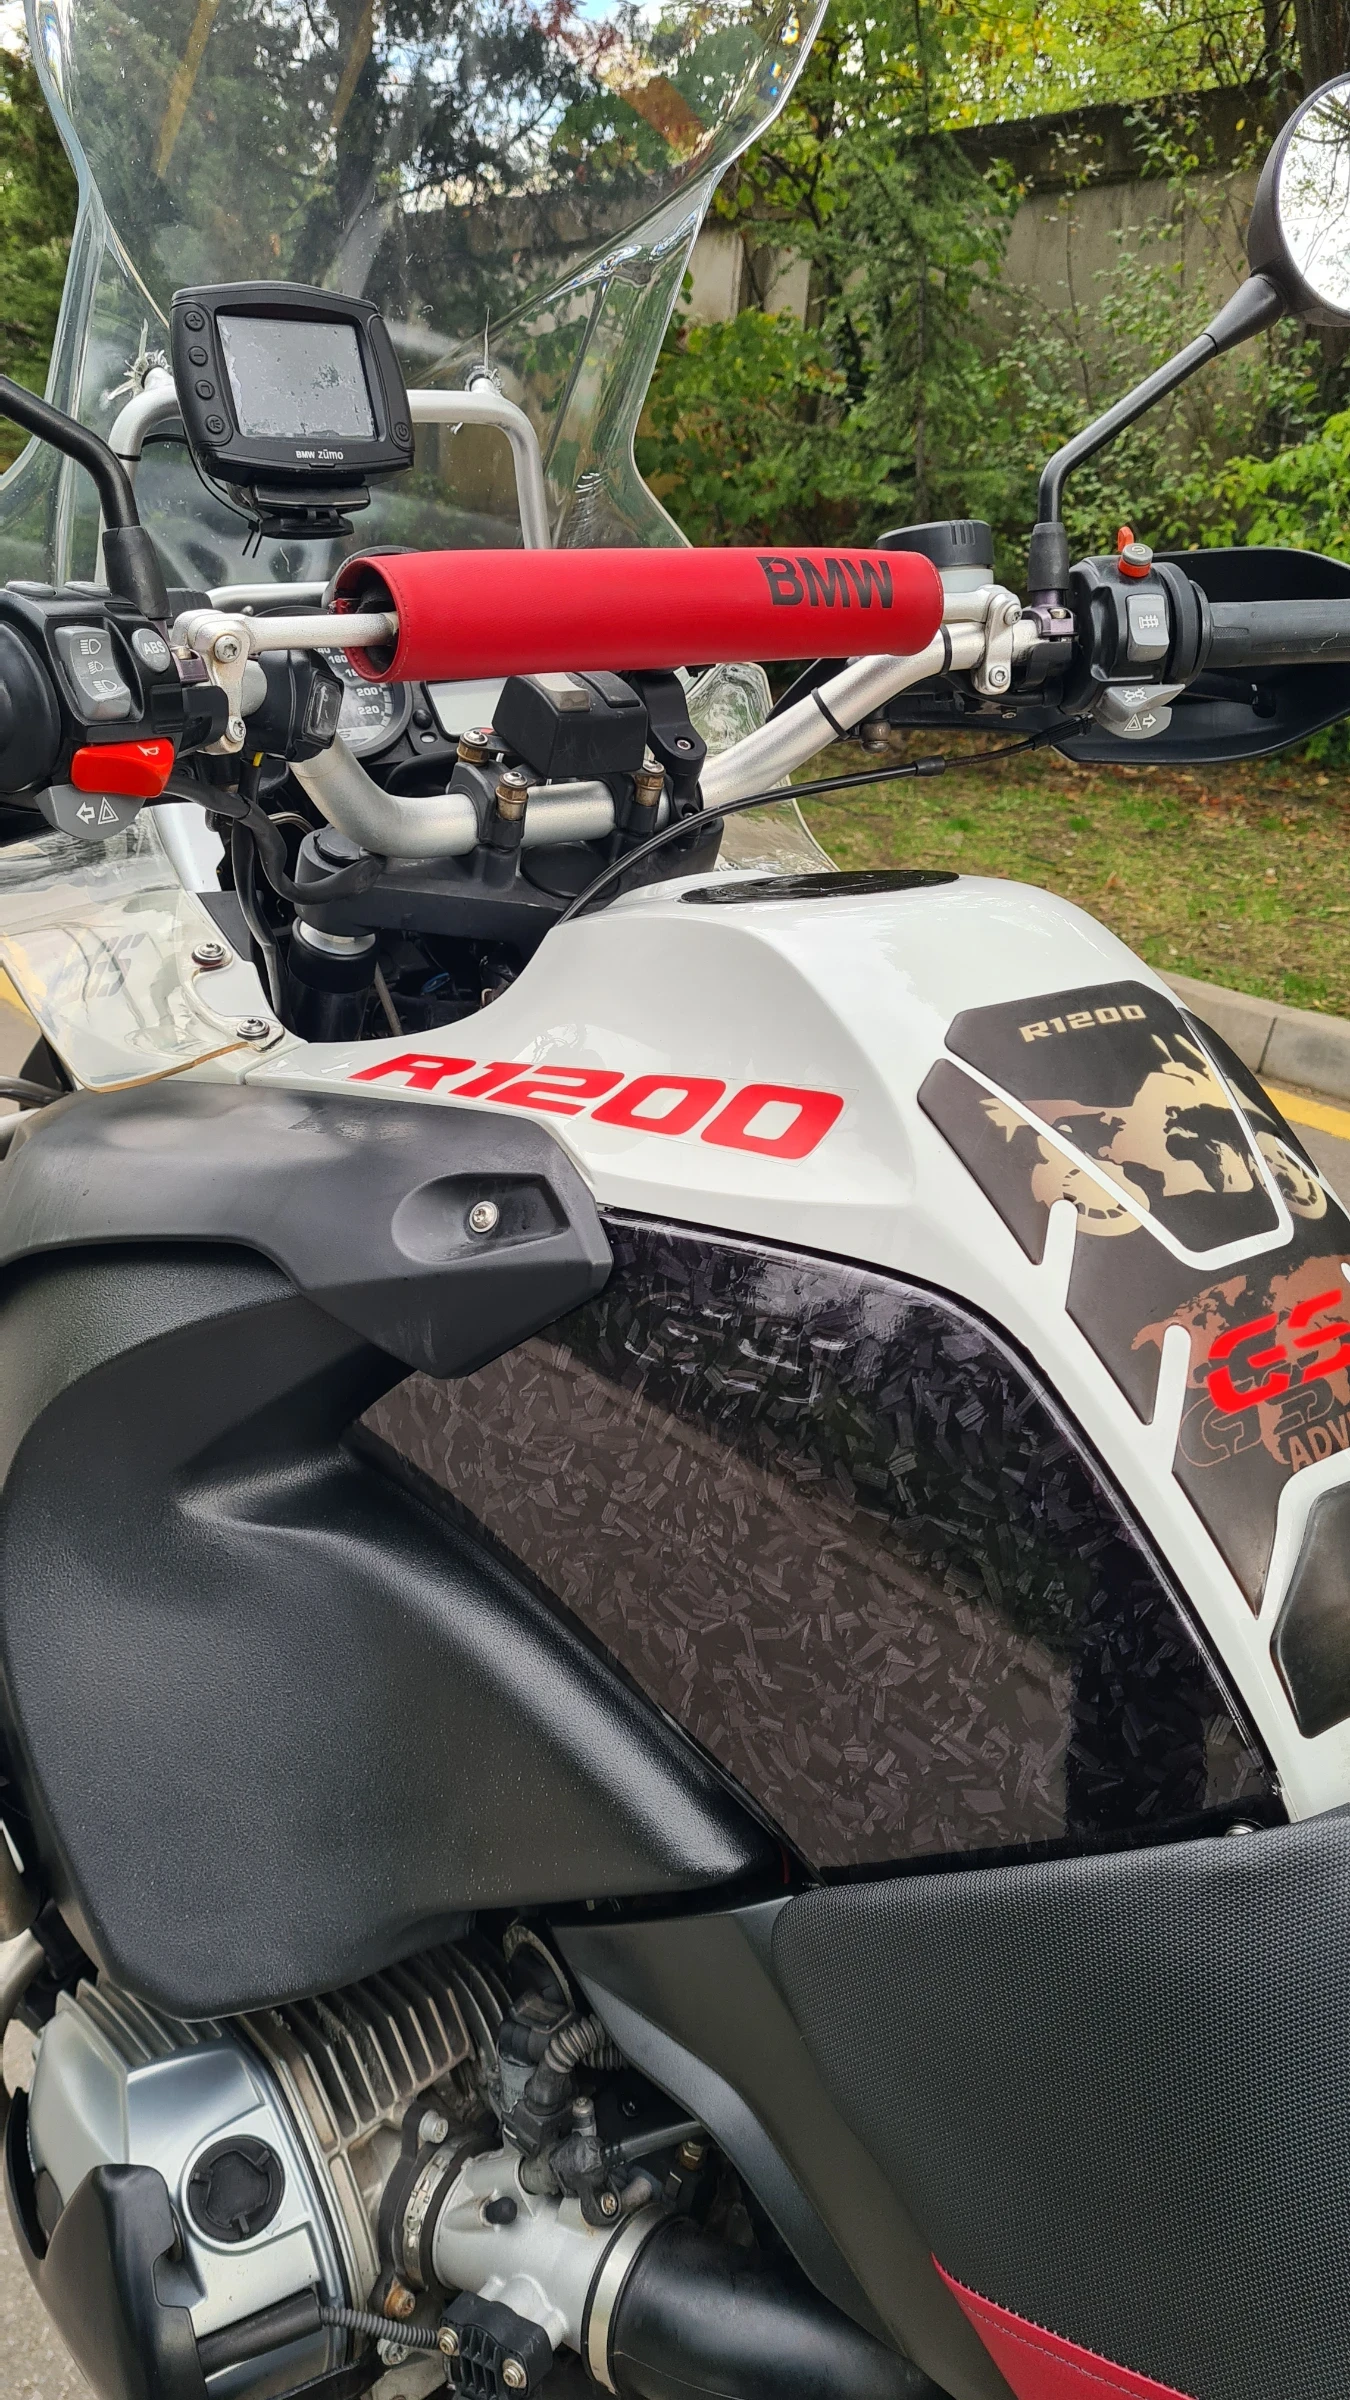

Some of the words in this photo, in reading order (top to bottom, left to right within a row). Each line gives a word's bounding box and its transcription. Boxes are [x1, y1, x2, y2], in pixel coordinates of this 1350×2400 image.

[295, 450, 315, 459] BMW
[756, 556, 894, 609] BMW
[143, 640, 166, 655] ABS
[356, 687, 379, 697] 200
[357, 705, 380, 715] 220
[1019, 1004, 1147, 1043] R1200
[346, 1052, 845, 1160] R1200
[1207, 1287, 1350, 1415] GS
[1288, 1411, 1350, 1473] ADV
